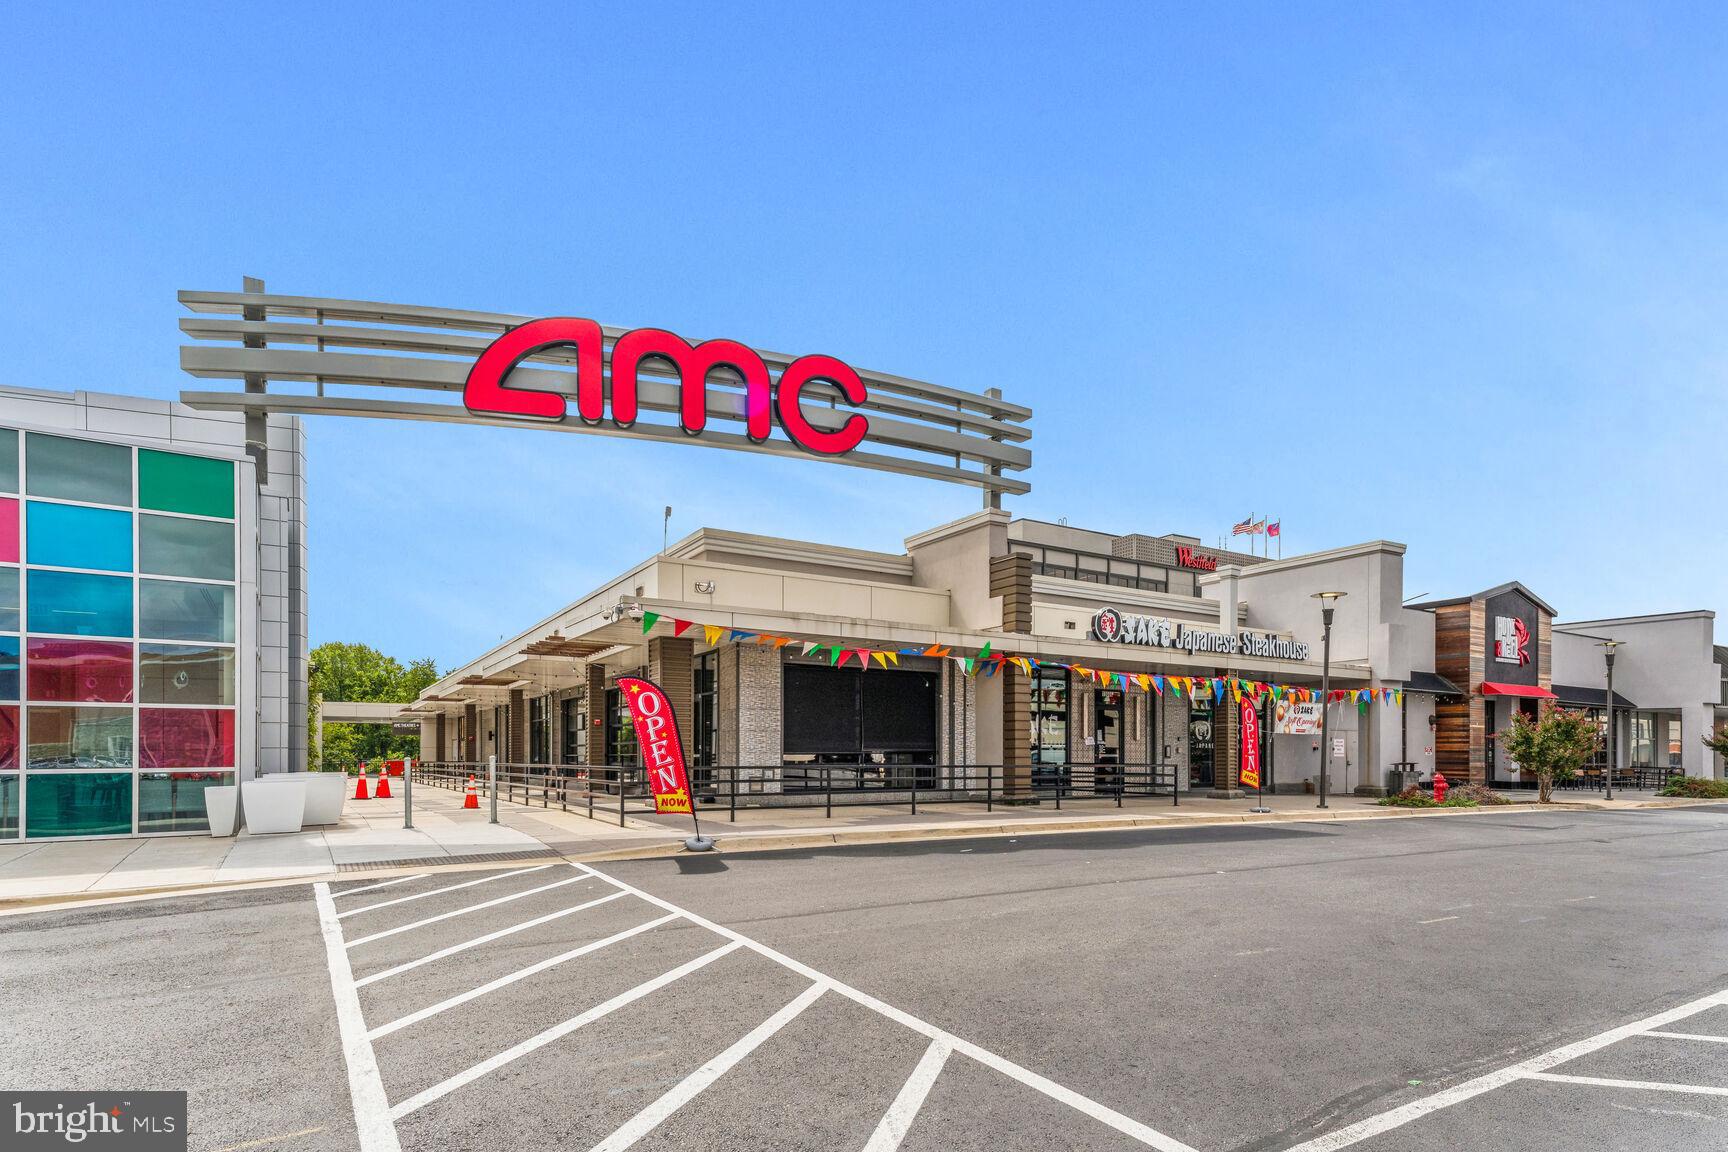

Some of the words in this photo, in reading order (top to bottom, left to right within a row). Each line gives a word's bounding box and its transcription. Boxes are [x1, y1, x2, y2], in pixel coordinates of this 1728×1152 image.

[1177, 545, 1217, 571] Westfield
[1175, 623, 1236, 655] Japanese
[1242, 630, 1310, 660] Steakhouse
[638, 691, 678, 793] OPEN
[1245, 708, 1255, 771] OPEN
[1244, 773, 1258, 784] NOW
[661, 797, 687, 807] NOW
